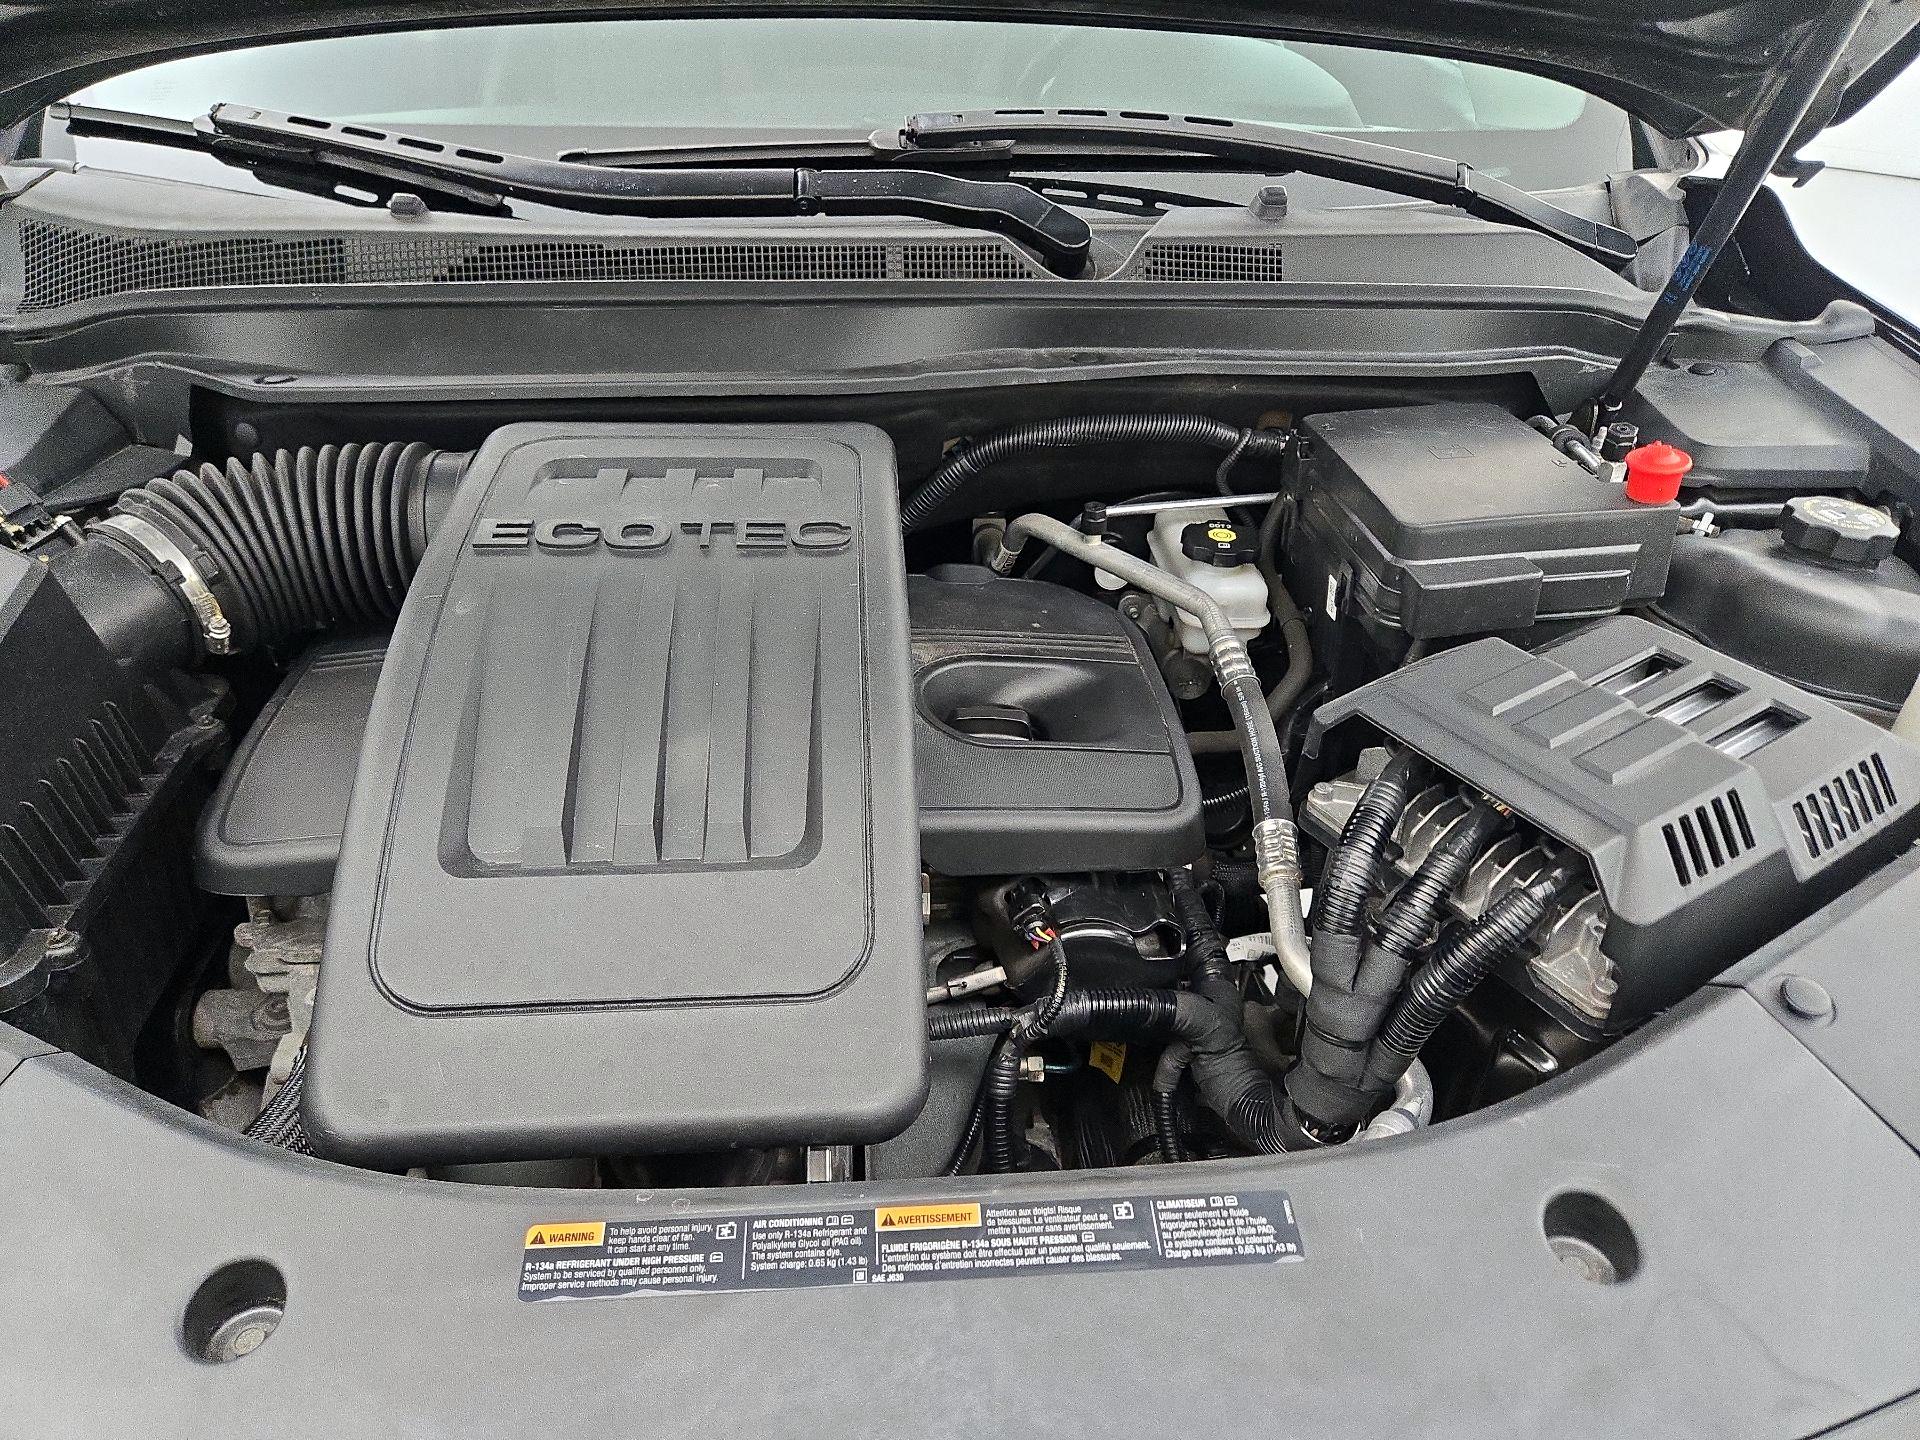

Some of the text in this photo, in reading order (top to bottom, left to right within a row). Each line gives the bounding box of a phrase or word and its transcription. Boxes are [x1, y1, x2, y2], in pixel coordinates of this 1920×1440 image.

[472, 520, 852, 550] ECOTEC
[1156, 1198, 1206, 1210] CLIMATISEUR
[897, 1212, 972, 1224] AVERTISSEMENT
[986, 1205, 1082, 1218] Attention aux doigts! Risque
[1159, 1208, 1250, 1221] Utiliser seulement le fluide
[753, 1216, 824, 1229] AIR CONDITIONING
[986, 1218, 997, 1226] de
[998, 1216, 1033, 1226] blessures.
[1034, 1215, 1042, 1224] Le
[1044, 1213, 1081, 1224] ventilateur
[1082, 1213, 1098, 1222] peut
[1199, 1218, 1226, 1228] R-134a
[1226, 1218, 1234, 1226] et
[1235, 1217, 1244, 1226] de
[610, 1223, 714, 1236] To help avoid personal injury.
[752, 1226, 868, 1242] Use only R-134a Refrigerant and
[988, 1226, 1010, 1236] mettre
[1018, 1224, 1044, 1234] tourner
[1046, 1224, 1062, 1232] sans
[1064, 1221, 1115, 1232] avertissement.
[550, 1232, 594, 1242] WARNING
[608, 1232, 694, 1246] keep hands clear of fan.
[752, 1241, 796, 1251] Polyalkylene
[798, 1239, 820, 1250] Glycol
[822, 1238, 830, 1247] oil
[832, 1236, 848, 1247] (PAG
[882, 1234, 1078, 1254] FLUIDE FRIGORIGÈNE R-134a SOUS HAUTE PRESSION
[1164, 1240, 1174, 1248] Le
[1174, 1238, 1204, 1249] système
[1205, 1236, 1234, 1246] contient
[1235, 1236, 1244, 1245] du
[608, 1246, 612, 1254] It
[629, 1244, 646, 1253] start
[648, 1244, 656, 1252] at
[656, 1244, 670, 1252] any
[672, 1242, 690, 1250] time.
[752, 1248, 842, 1262] The system contains dye.
[921, 1251, 930, 1260] du
[932, 1250, 962, 1262] système
[963, 1249, 977, 1258] doit
[978, 1248, 992, 1258] être
[994, 1246, 1023, 1257] effectué
[1025, 1246, 1036, 1256] par
[1038, 1246, 1048, 1254] un
[1048, 1244, 1084, 1254] personnel
[1086, 1242, 1111, 1253] qualifié
[1112, 1240, 1152, 1250] seulement.
[1166, 1248, 1191, 1260] Charge
[1192, 1248, 1202, 1257] du
[1203, 1246, 1234, 1258] système
[1256, 1244, 1266, 1256] kg
[525, 1254, 704, 1271] R-134a REFRIGERANT UNDER HIGH PRESSURE
[750, 1256, 868, 1272] System charge: 0.65 kg (1.43 lb)
[882, 1264, 896, 1272] Des
[898, 1261, 934, 1272] méthodes
[974, 1256, 1014, 1269] incorrectes
[1016, 1256, 1044, 1268] peuvent
[1046, 1254, 1070, 1264] causer
[1072, 1254, 1085, 1262] des
[1086, 1252, 1122, 1262] blessures.
[524, 1271, 552, 1282] System
[562, 1270, 572, 1278] be
[574, 1269, 606, 1278] serviced
[608, 1268, 618, 1278] by
[618, 1266, 650, 1277] qualified
[651, 1264, 688, 1276] personnel
[689, 1264, 706, 1274] only.
[872, 1274, 886, 1282] SAE
[522, 1273, 719, 1292] Improper service methods may cause personal injury.
